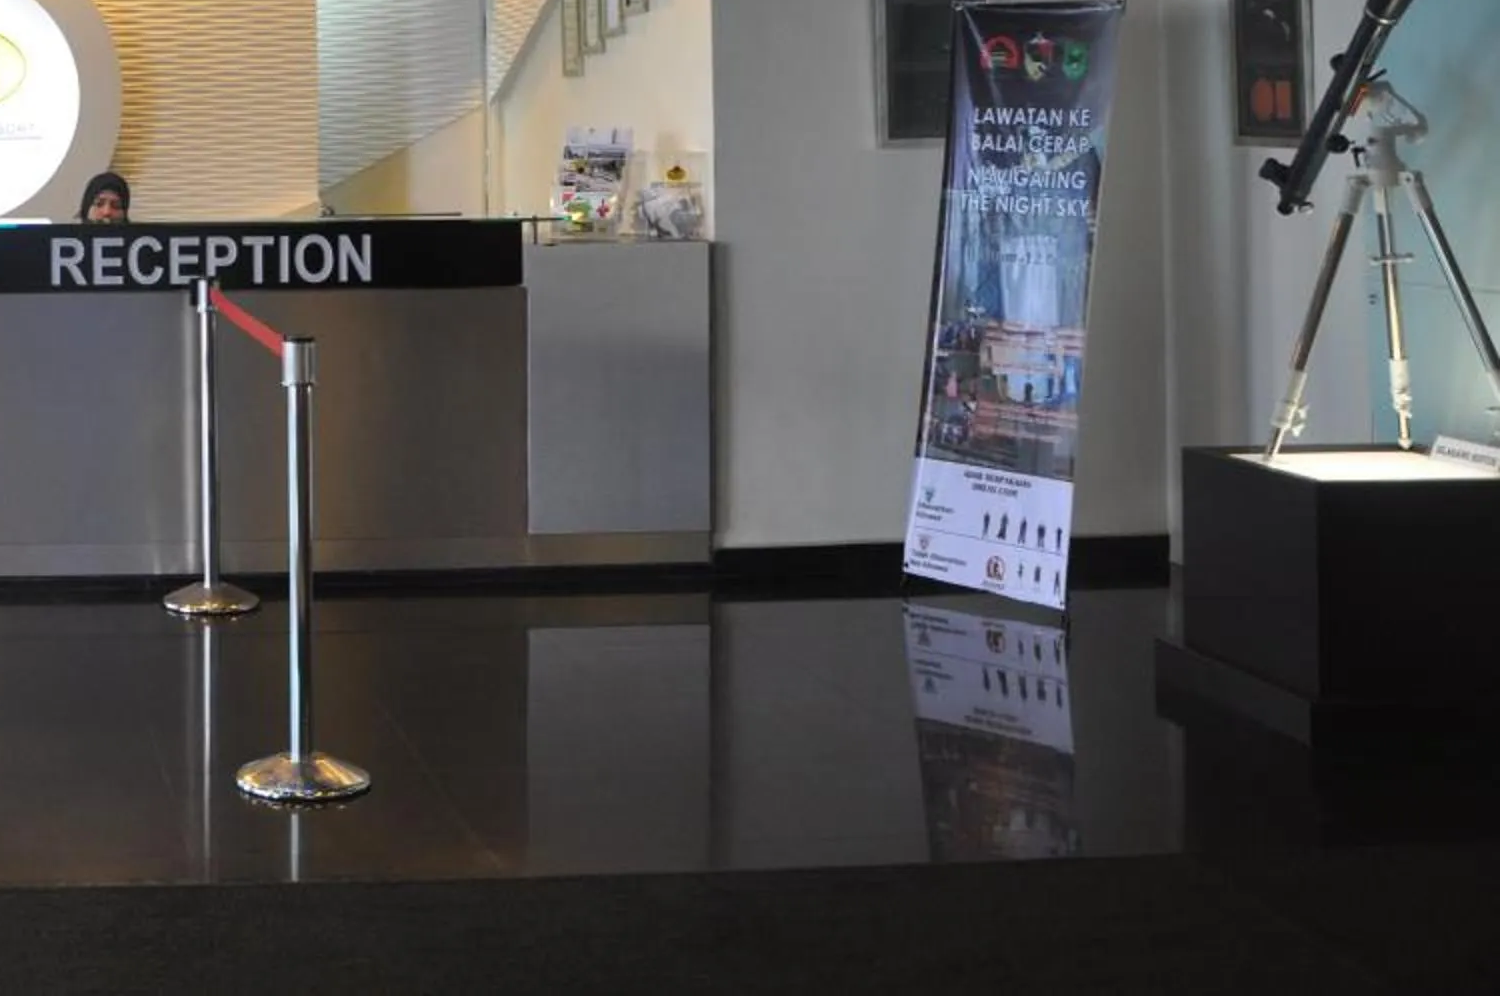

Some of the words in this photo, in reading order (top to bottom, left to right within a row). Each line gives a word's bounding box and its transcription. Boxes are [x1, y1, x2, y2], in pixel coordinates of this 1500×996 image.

[974, 108, 1062, 125] LAWATAN
[1069, 109, 1091, 127] KE
[971, 134, 1023, 152] BALAI
[1028, 135, 1088, 154] CERAP
[968, 167, 1086, 189] NAVIGATING
[960, 193, 990, 211] THE
[996, 196, 1050, 215] NIGHT
[1057, 199, 1090, 217] SKY
[50, 234, 372, 286] RECEPTION
